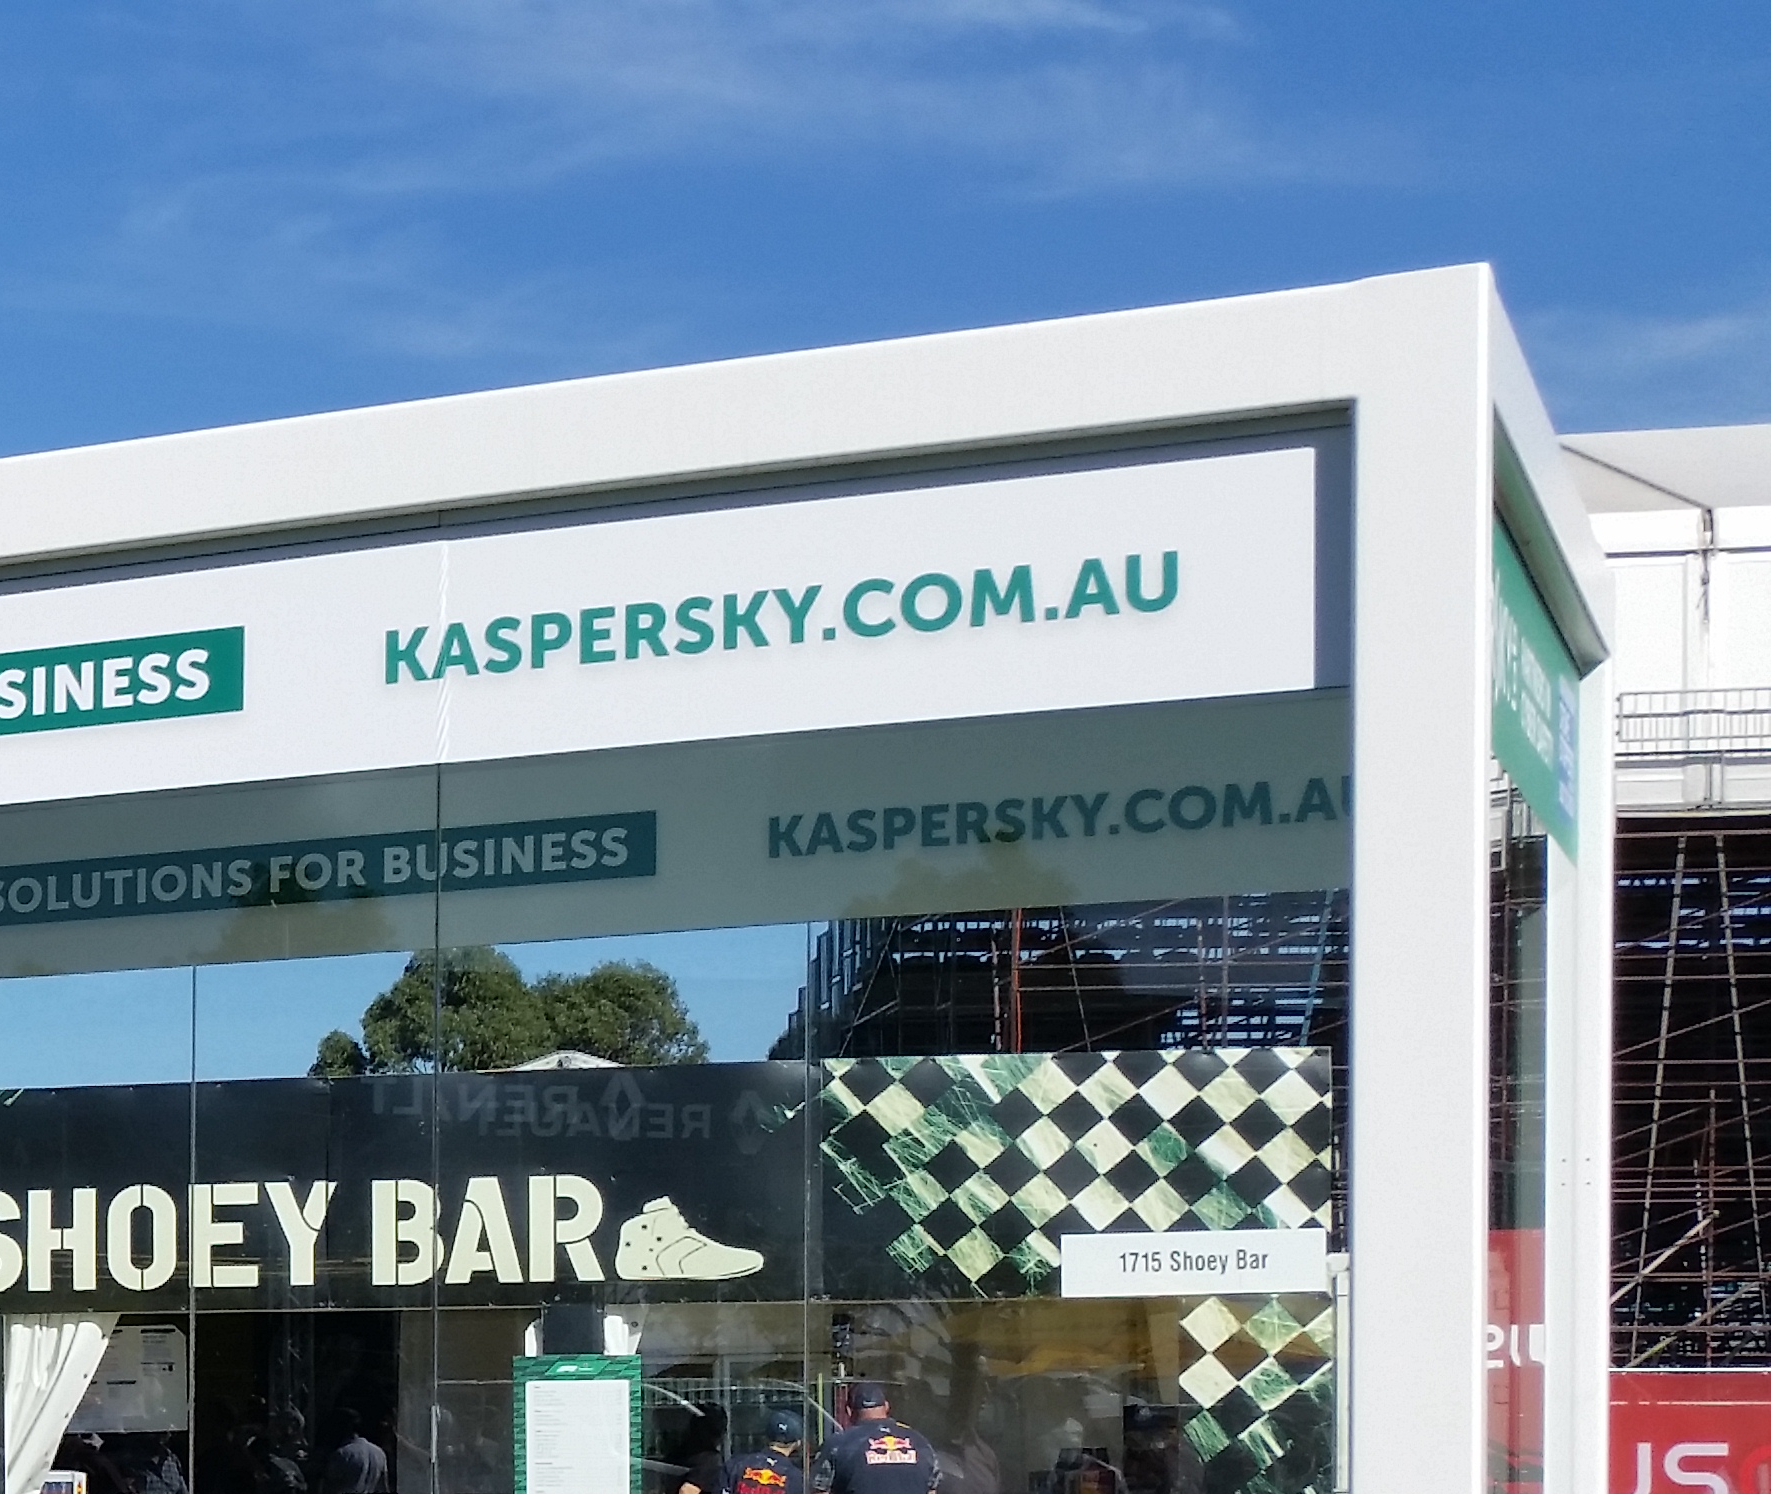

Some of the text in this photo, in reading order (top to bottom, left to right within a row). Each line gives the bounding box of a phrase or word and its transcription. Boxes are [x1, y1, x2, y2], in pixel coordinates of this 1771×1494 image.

[384, 550, 1180, 686] KASPERSKY.COM.AU
[269, 849, 365, 893] FOR
[382, 827, 630, 885] BUSINESS
[371, 1175, 605, 1286] BAR
[1119, 1249, 1269, 1275] 1715 Shoey Bar
